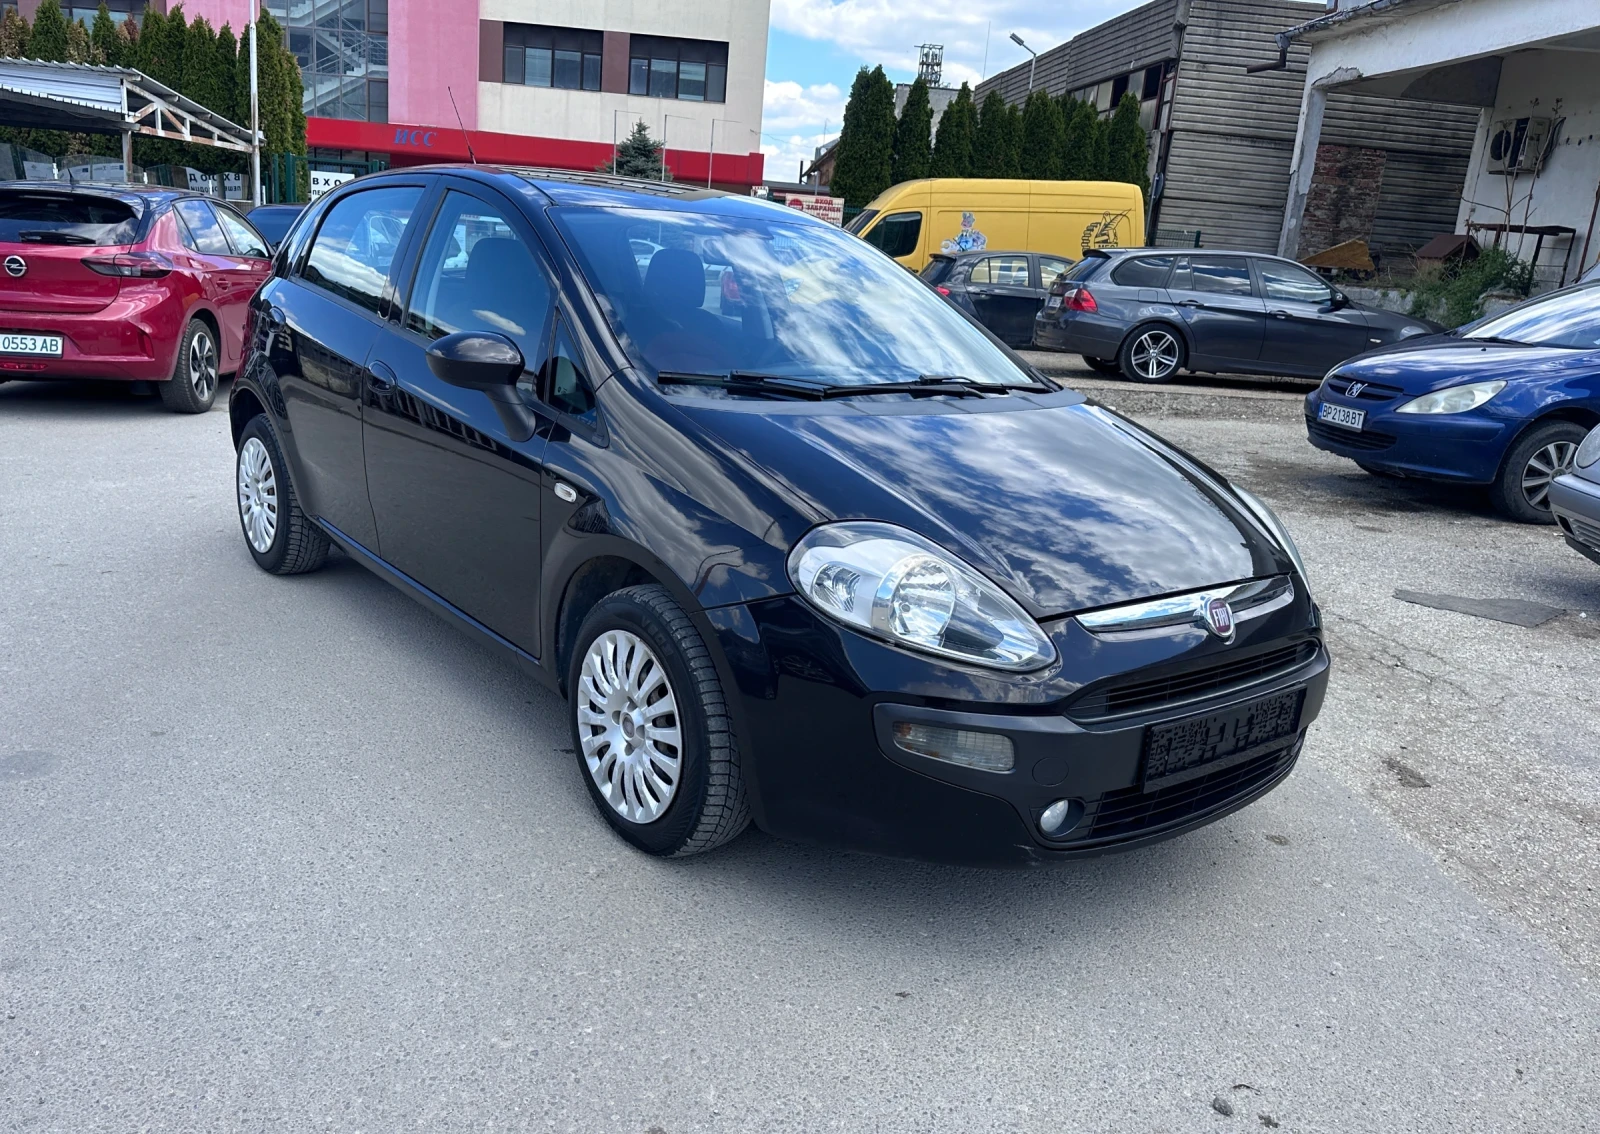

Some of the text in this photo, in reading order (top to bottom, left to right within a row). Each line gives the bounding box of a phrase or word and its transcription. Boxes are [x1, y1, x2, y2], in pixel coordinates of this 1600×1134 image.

[394, 129, 437, 147] ИСС
[312, 177, 342, 186] ВХО
[805, 204, 841, 212] ЗАБРАНЕН
[815, 198, 833, 206] ВХОД
[2, 336, 59, 352] 0553 AB
[1212, 607, 1230, 627] FIAT
